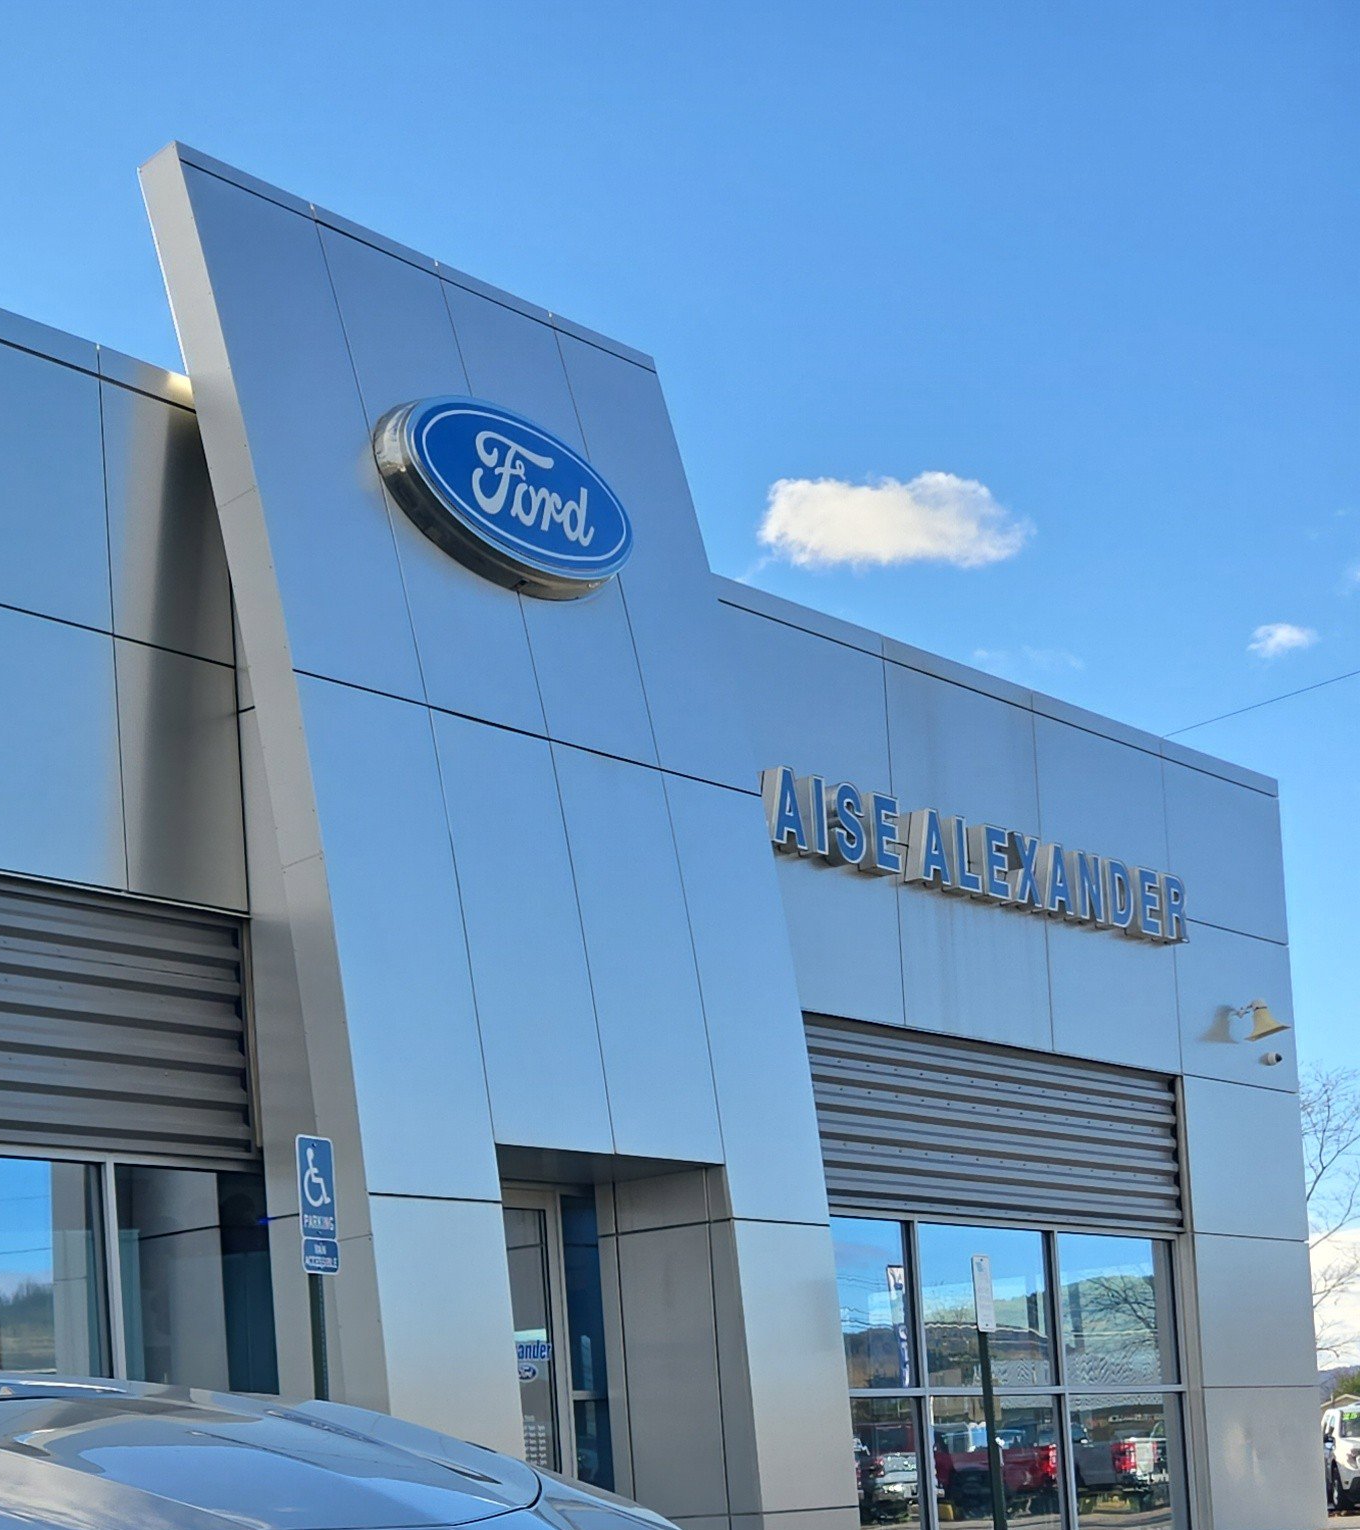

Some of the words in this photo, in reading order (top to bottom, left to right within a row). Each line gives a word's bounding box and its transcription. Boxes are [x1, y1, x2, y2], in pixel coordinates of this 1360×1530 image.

[471, 430, 595, 547] Ford
[768, 766, 903, 875] AISE
[918, 807, 1189, 943] ALEXANDER
[516, 1339, 551, 1360] ander
